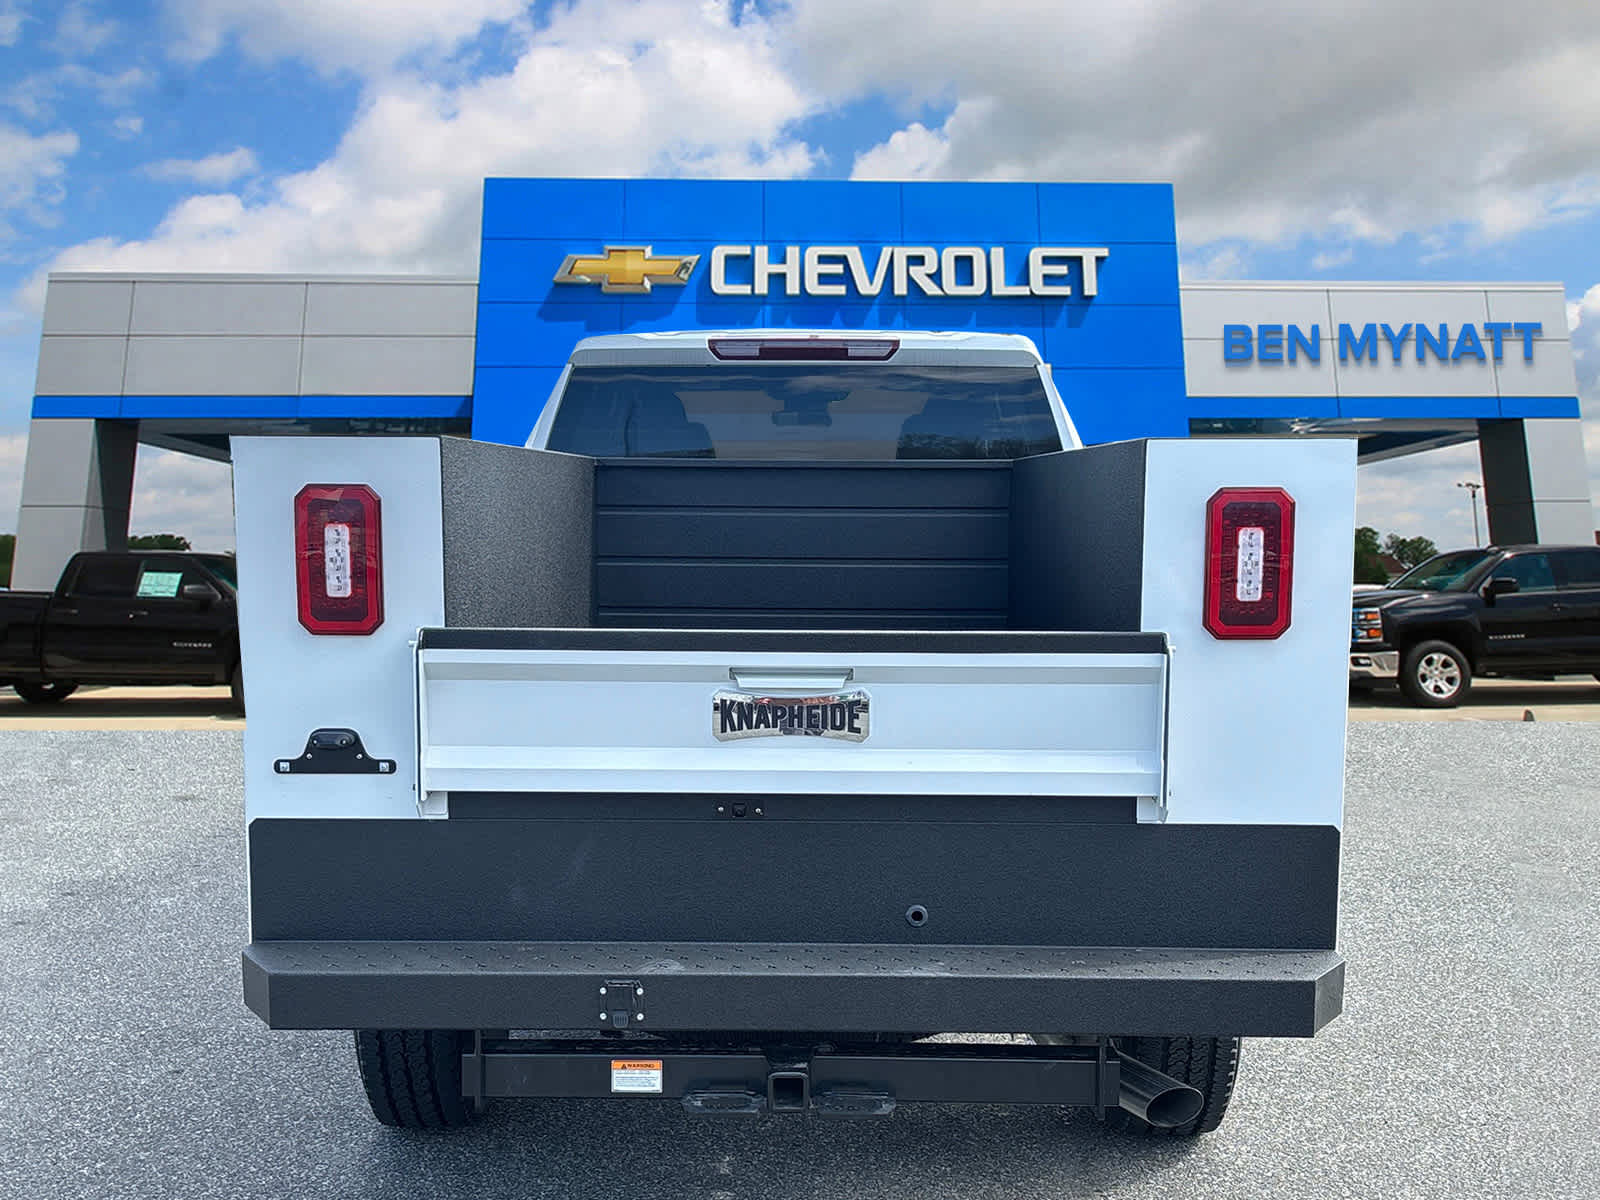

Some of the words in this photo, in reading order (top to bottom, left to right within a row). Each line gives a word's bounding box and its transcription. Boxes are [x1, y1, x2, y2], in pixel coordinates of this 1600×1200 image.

[711, 245, 1109, 296] CHEVROLET
[1223, 324, 1320, 362] BEN
[1338, 322, 1542, 362] MYNATT
[720, 697, 862, 734] KNAPHEIDE
